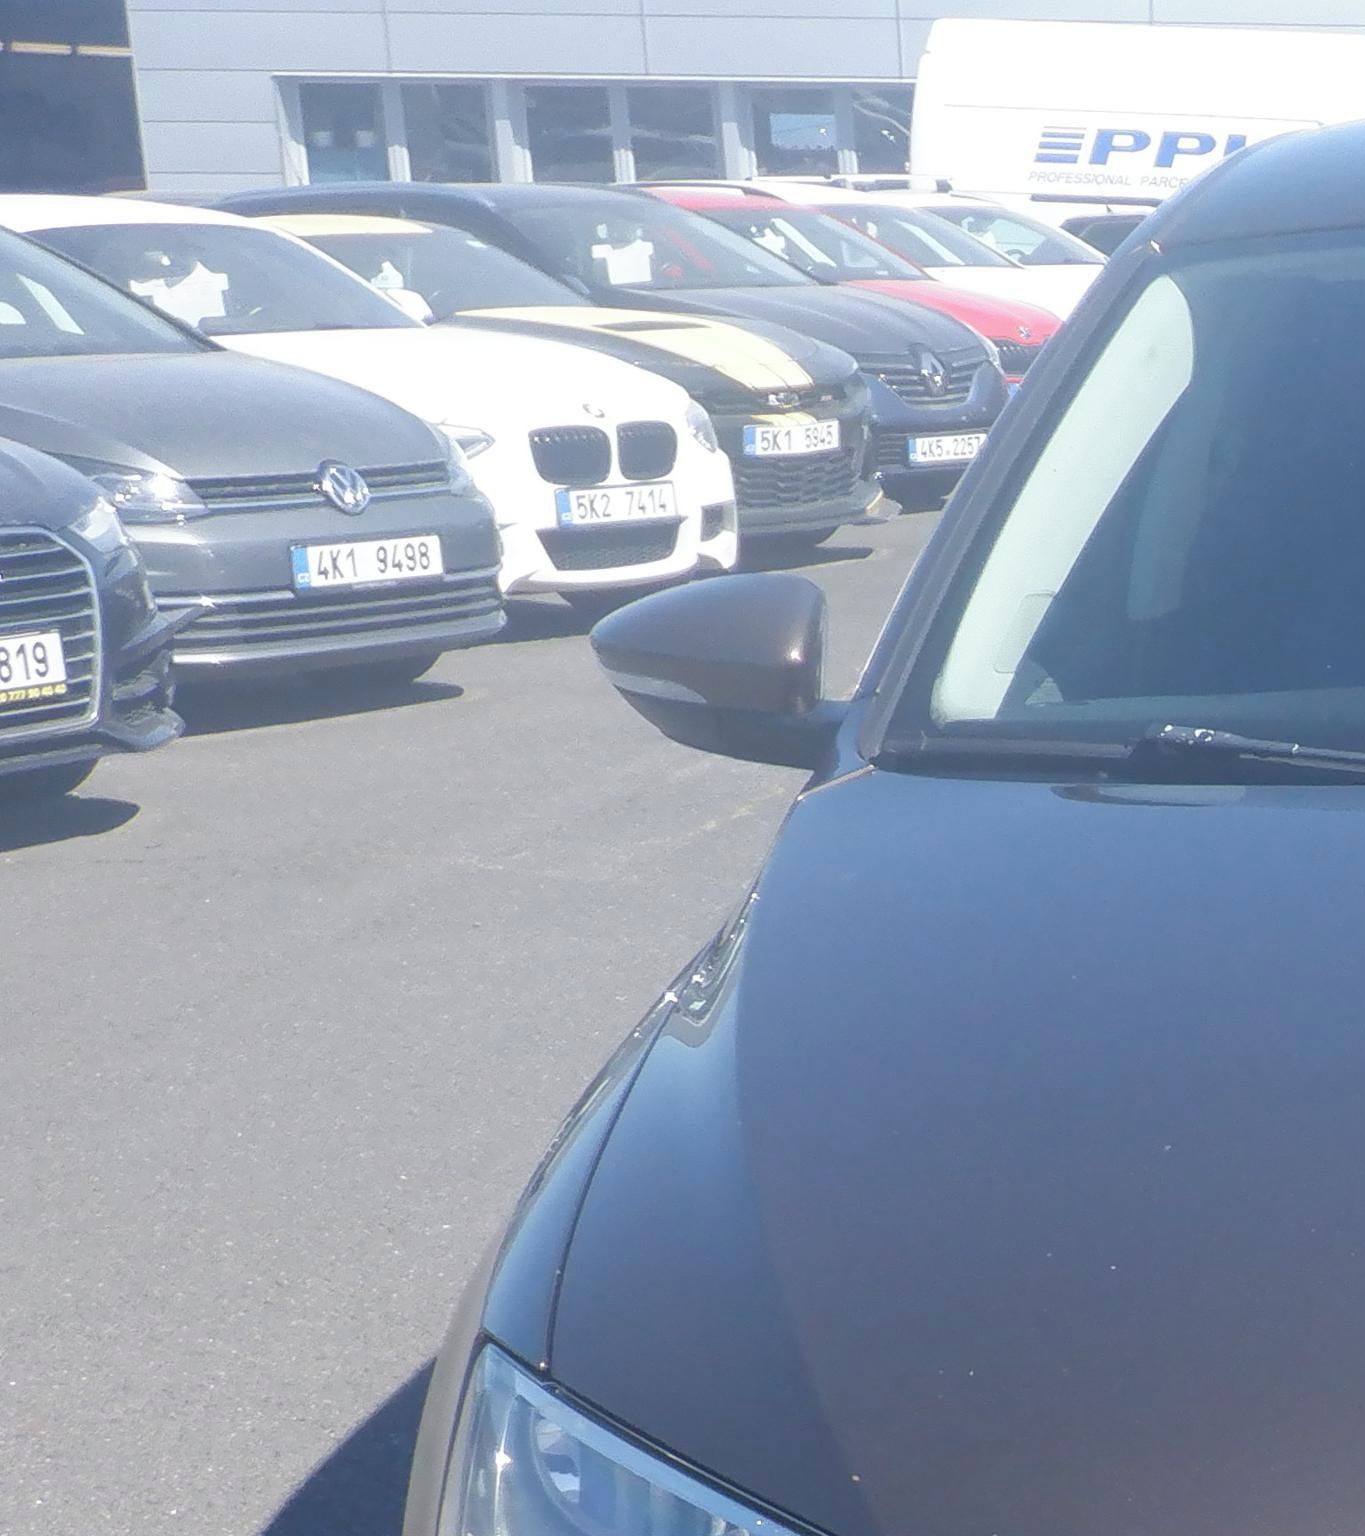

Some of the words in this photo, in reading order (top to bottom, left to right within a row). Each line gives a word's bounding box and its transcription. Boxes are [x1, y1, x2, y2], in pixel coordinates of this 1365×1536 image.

[1028, 170, 1131, 187] PROFESSIONAL
[760, 430, 792, 452] 5K1
[920, 439, 943, 458] 4K5
[576, 493, 611, 519] 5K2
[625, 488, 667, 516] 7414
[317, 547, 358, 580] 4K1
[376, 541, 431, 574] 9498
